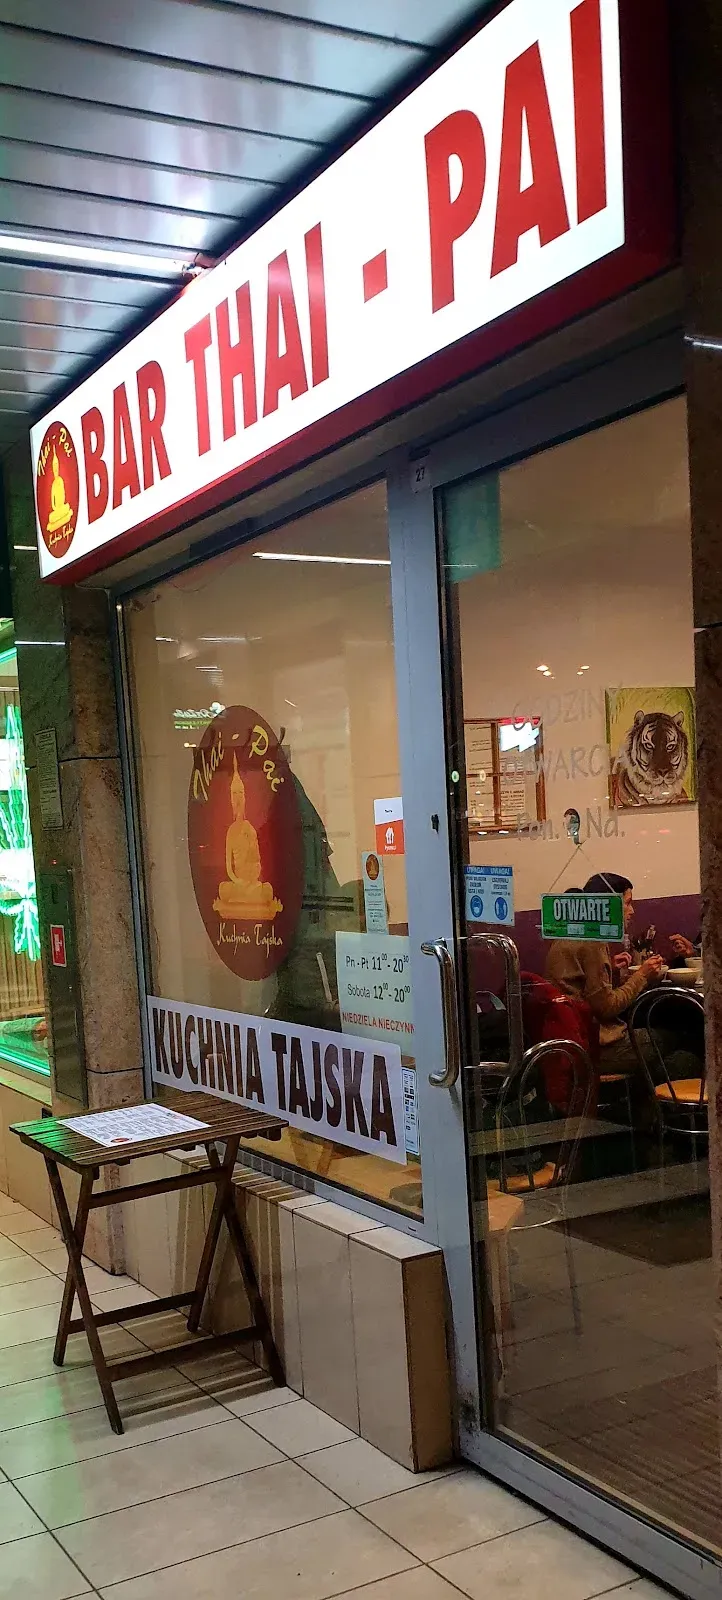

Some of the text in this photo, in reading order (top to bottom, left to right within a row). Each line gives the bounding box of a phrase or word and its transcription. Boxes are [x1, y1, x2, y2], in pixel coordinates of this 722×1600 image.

[81, 0, 608, 525] BAR THAI - PAI
[415, 466, 425, 482] 27
[193, 732, 225, 801] Thai
[249, 724, 285, 793] Pai
[553, 898, 611, 922] OTWARTE
[254, 923, 283, 959] Tajska
[347, 983, 371, 999] Sobota
[342, 1011, 378, 1028] NIEDZIELA
[152, 1007, 266, 1105] KUCHNIA
[271, 1032, 398, 1147] TAJSKA
